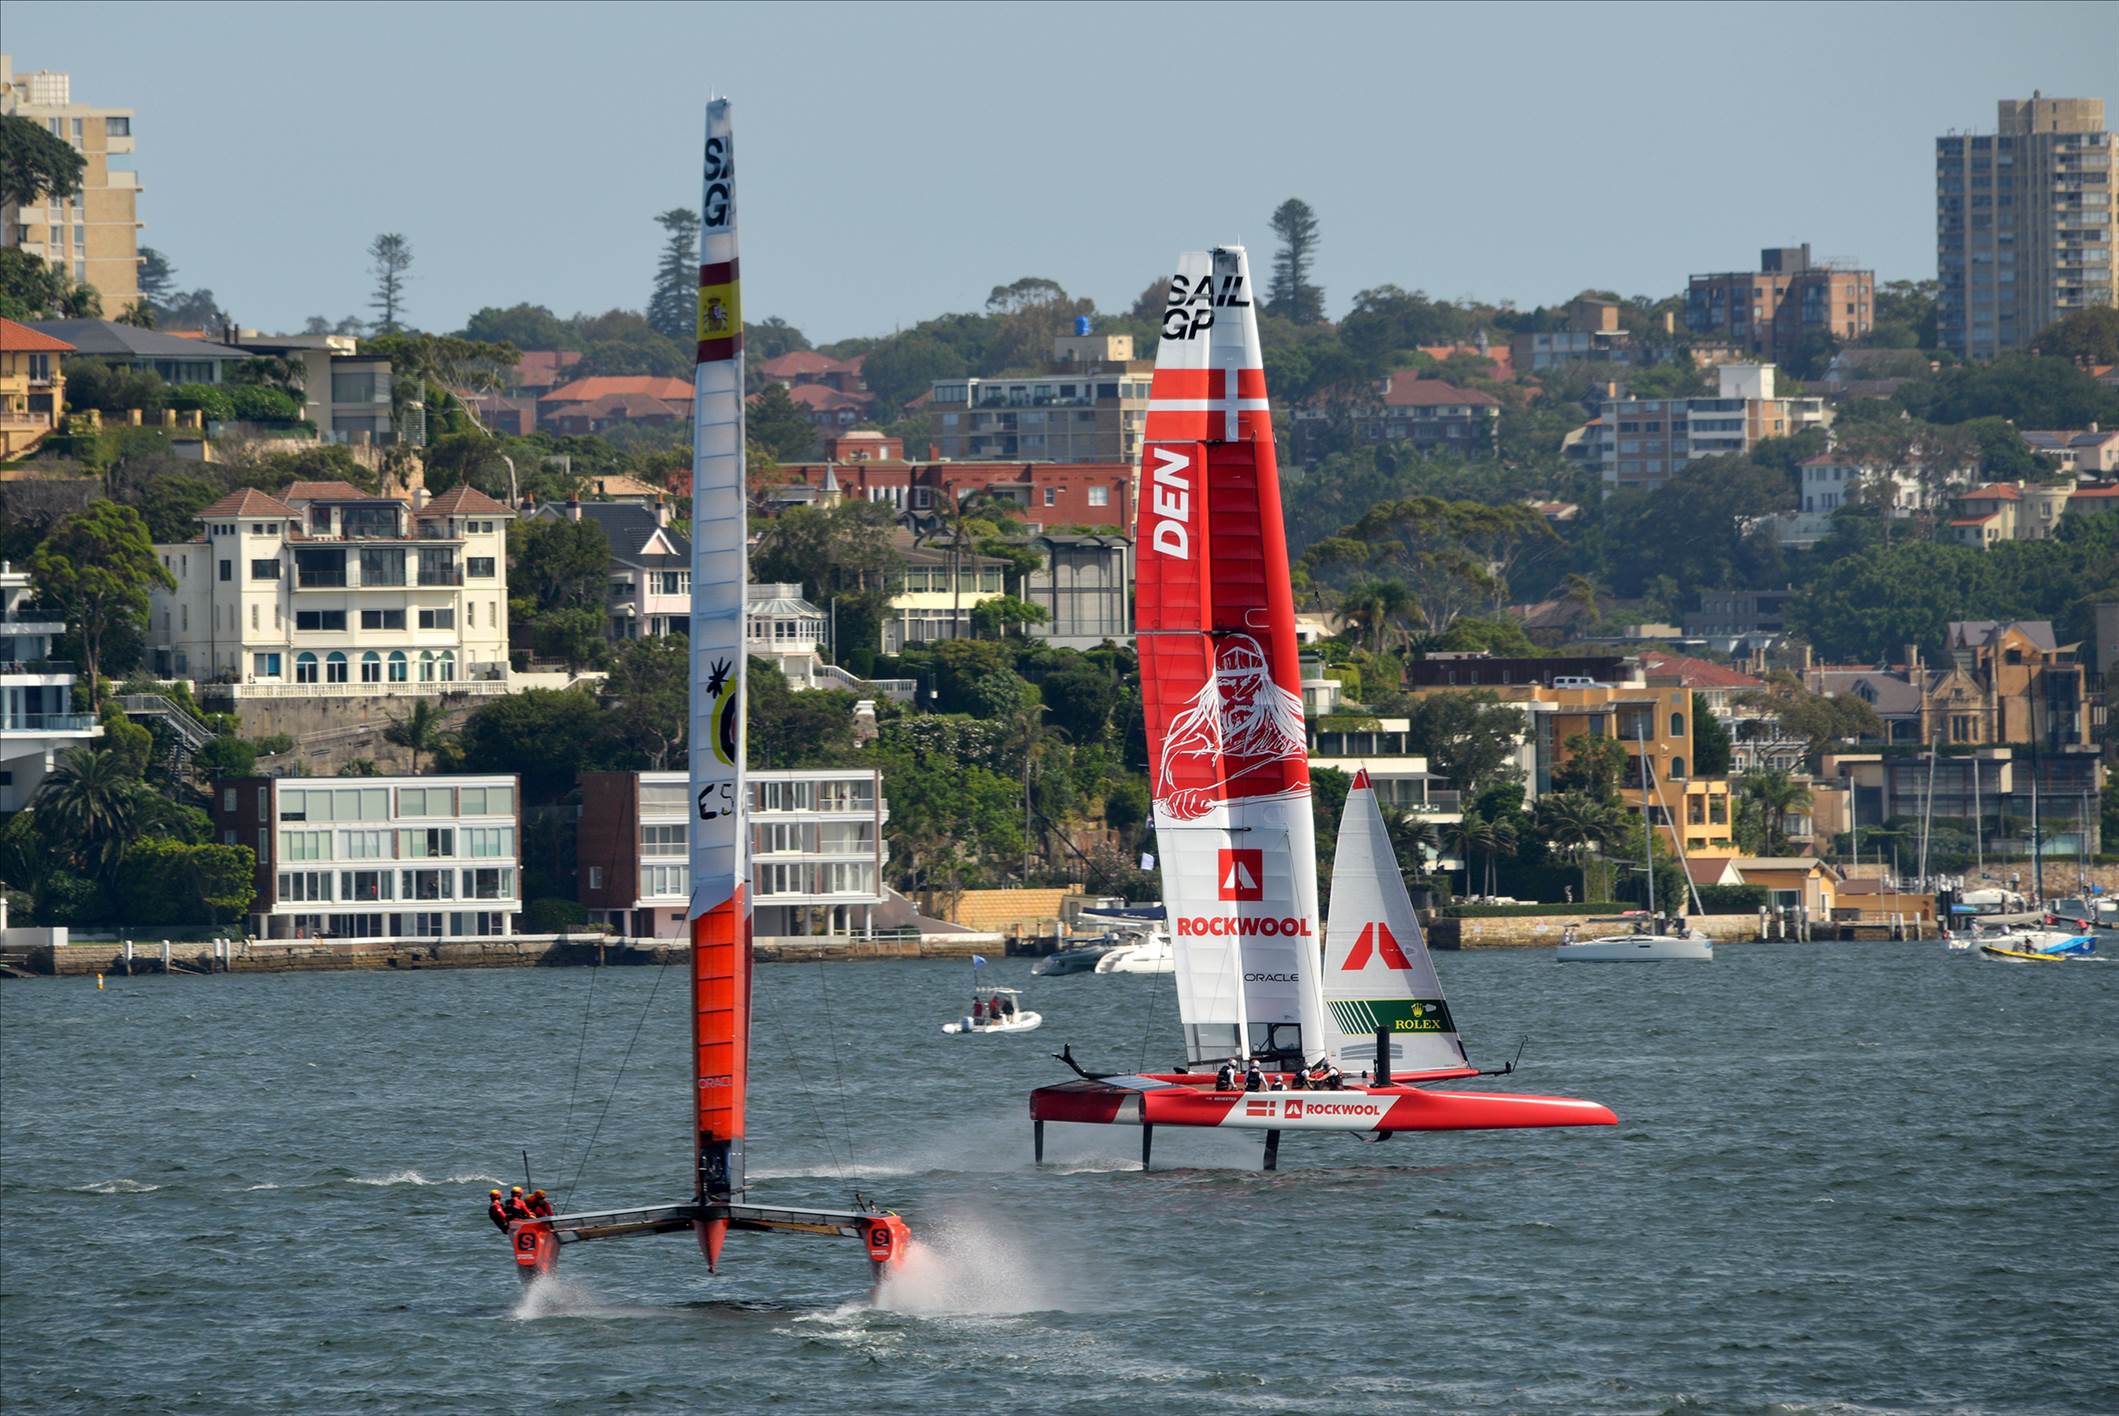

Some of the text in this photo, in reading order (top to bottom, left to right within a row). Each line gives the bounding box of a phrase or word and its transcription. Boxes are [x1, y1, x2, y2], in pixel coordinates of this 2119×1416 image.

[1168, 274, 1250, 307] SAIL
[1161, 308, 1216, 341] GP
[1153, 447, 1190, 560] DEN
[1177, 917, 1312, 937] ROCKWOOL
[1244, 973, 1300, 983] ORACLE
[1395, 1019, 1441, 1030] ROLEX
[1306, 1103, 1380, 1116] ROCKWOOL
